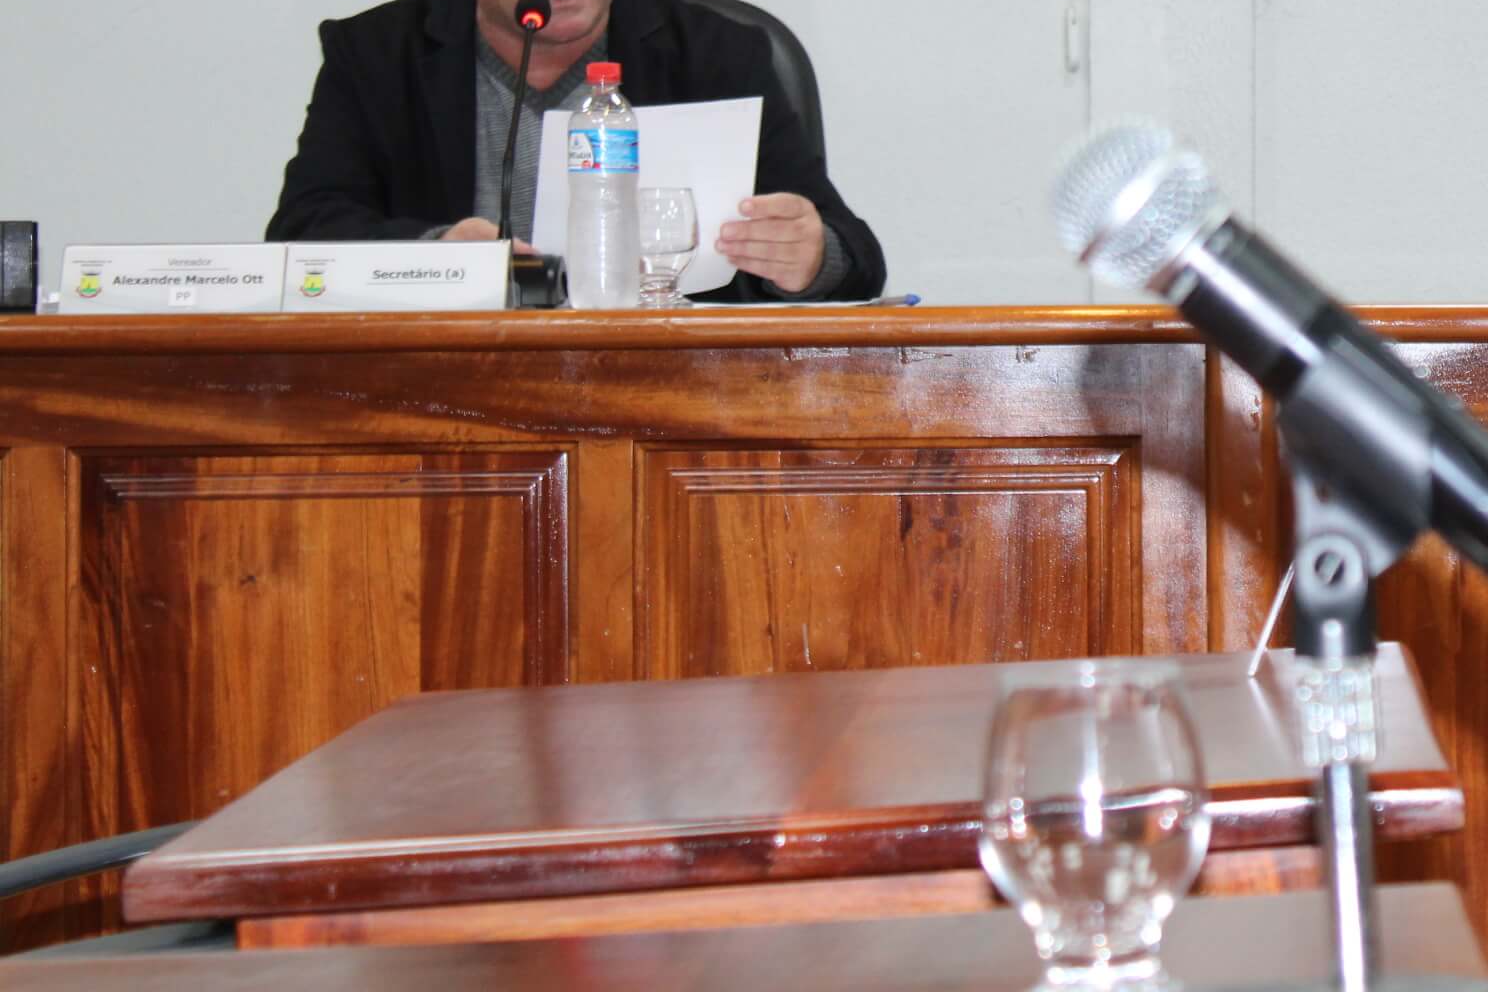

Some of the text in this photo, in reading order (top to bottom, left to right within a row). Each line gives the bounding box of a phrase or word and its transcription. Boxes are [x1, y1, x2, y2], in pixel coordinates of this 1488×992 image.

[168, 258, 214, 267] Vereador
[372, 268, 466, 281] Secretário (a)
[112, 274, 264, 286] Alexandre Marcelo Ott
[176, 292, 191, 301] PP
